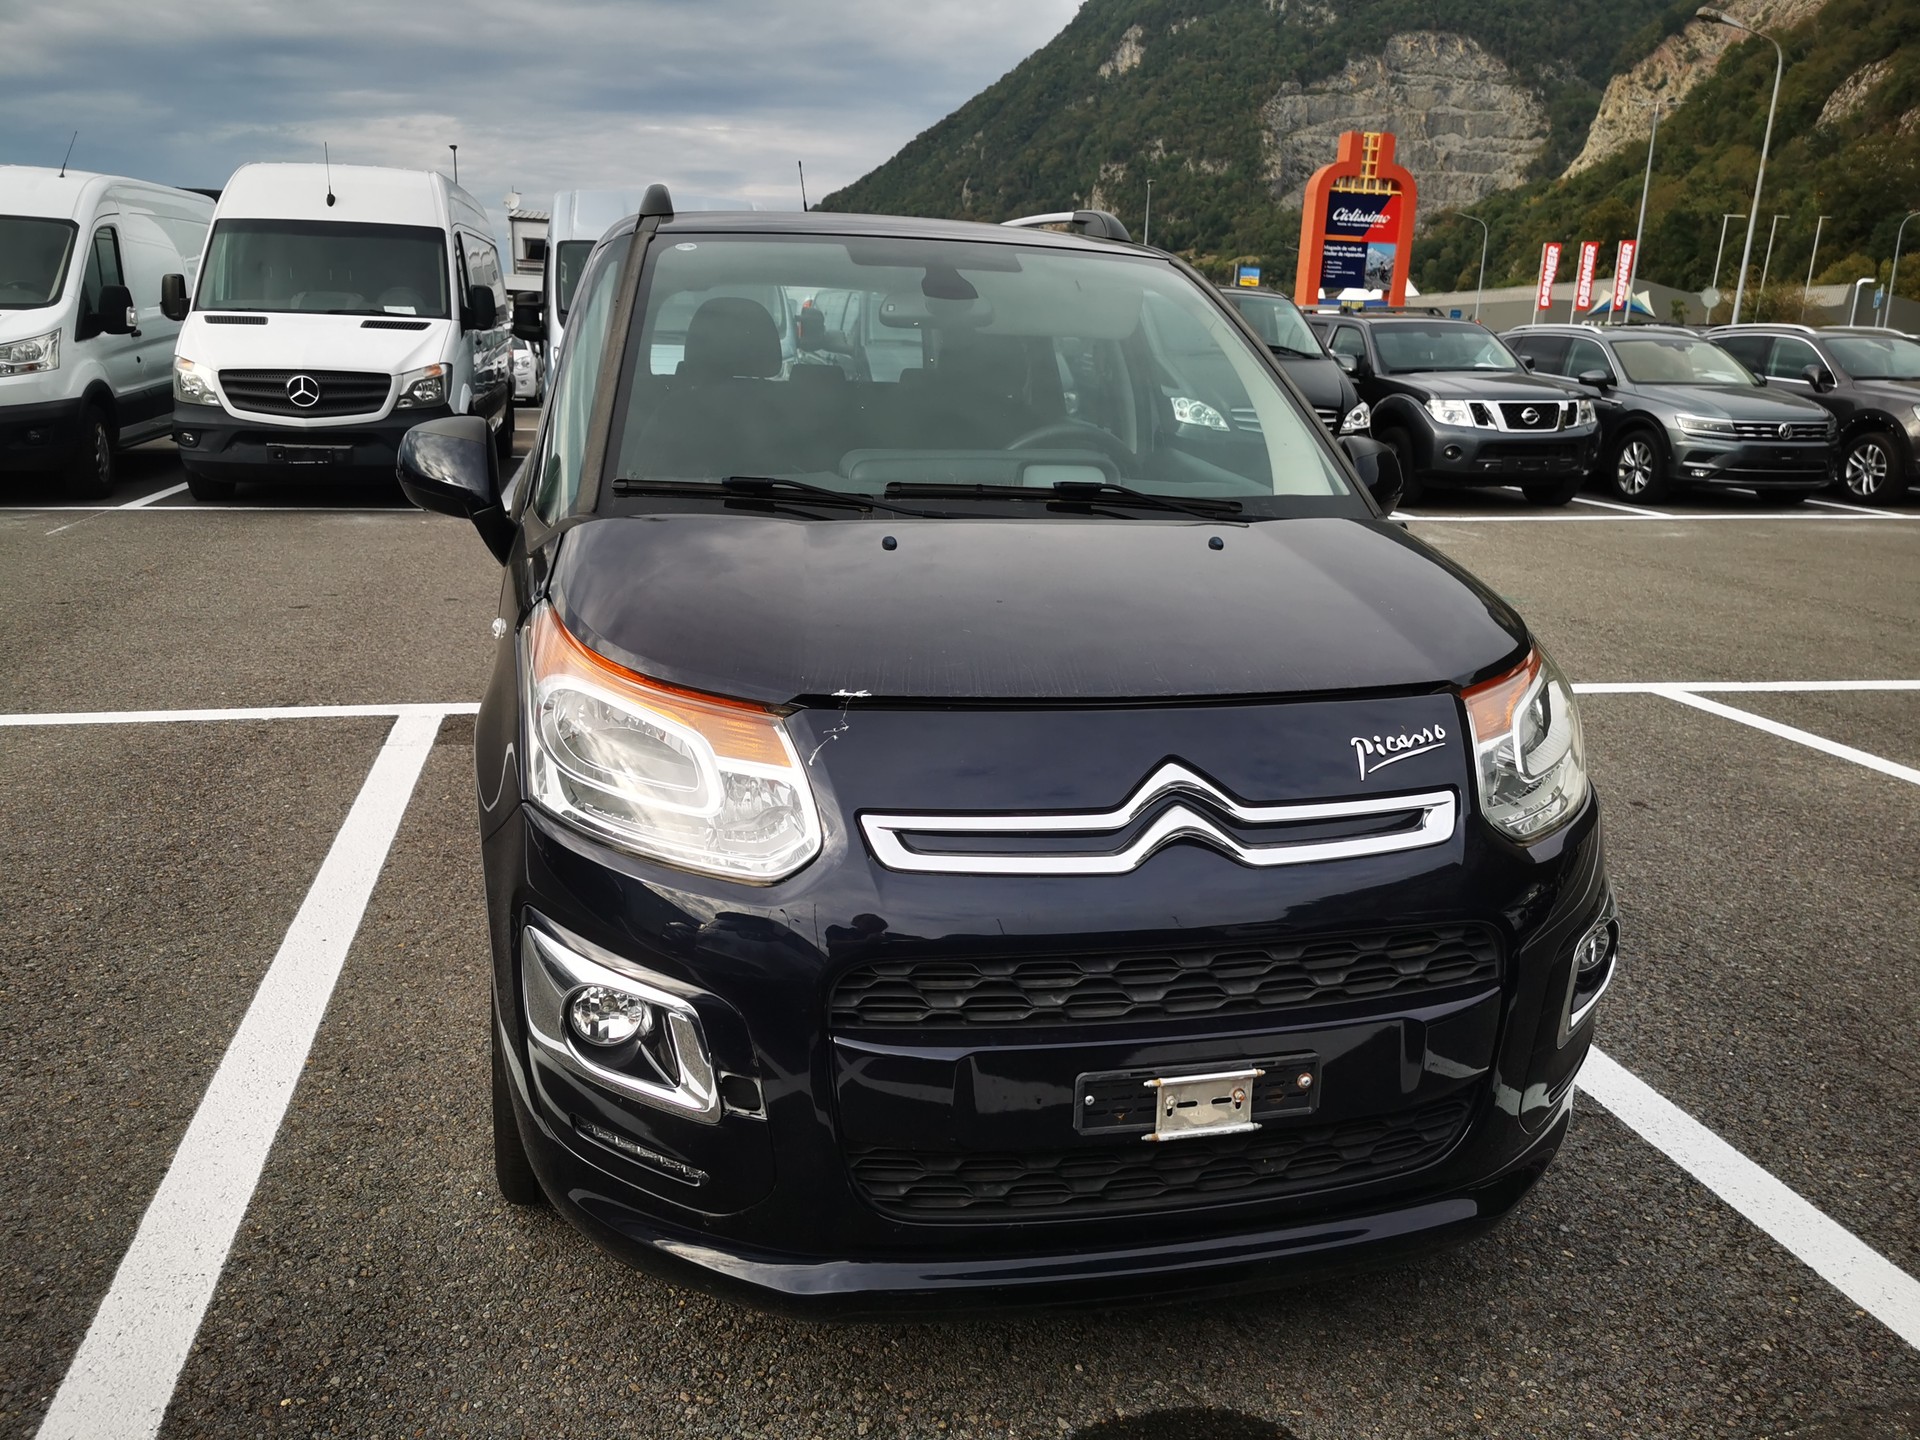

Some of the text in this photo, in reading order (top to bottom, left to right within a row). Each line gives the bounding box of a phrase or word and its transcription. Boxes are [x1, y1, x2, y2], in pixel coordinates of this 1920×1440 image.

[1332, 207, 1391, 223] Ciclissimo
[1540, 245, 1559, 306] DENNER
[1578, 244, 1596, 307] DENNER
[1615, 243, 1634, 307] DENNER
[1350, 724, 1446, 781] Picasso
